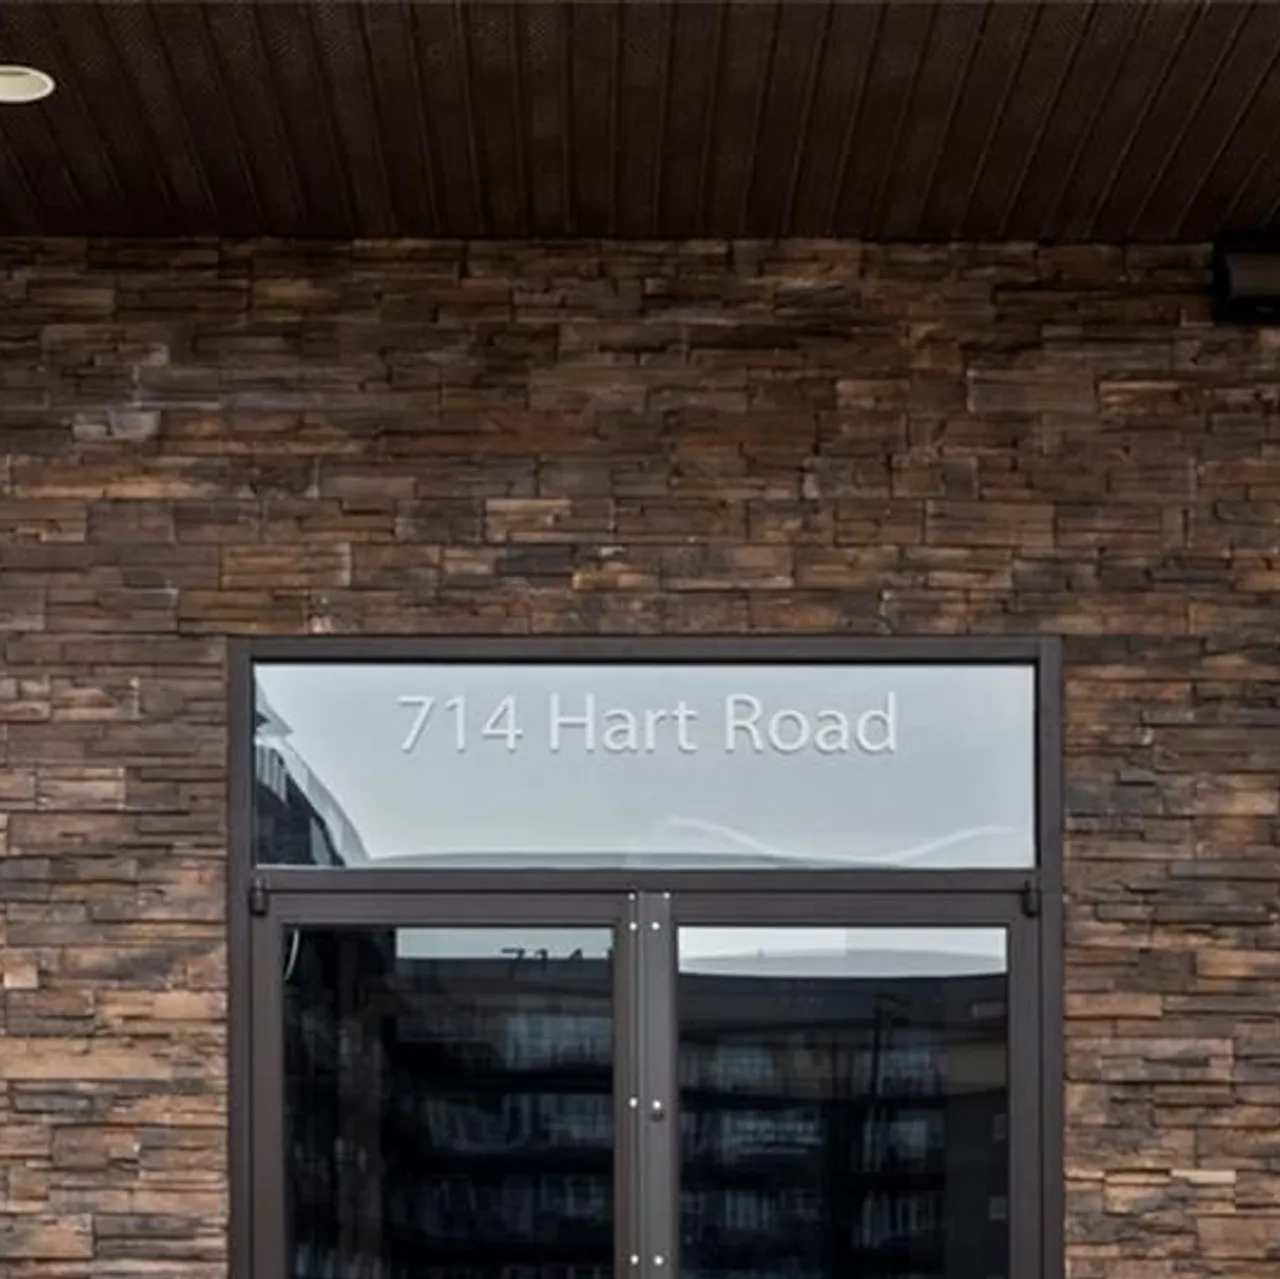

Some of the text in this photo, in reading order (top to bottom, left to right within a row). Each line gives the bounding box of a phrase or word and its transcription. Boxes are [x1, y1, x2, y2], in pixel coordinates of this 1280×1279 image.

[398, 691, 898, 753] 714 Hart Road
